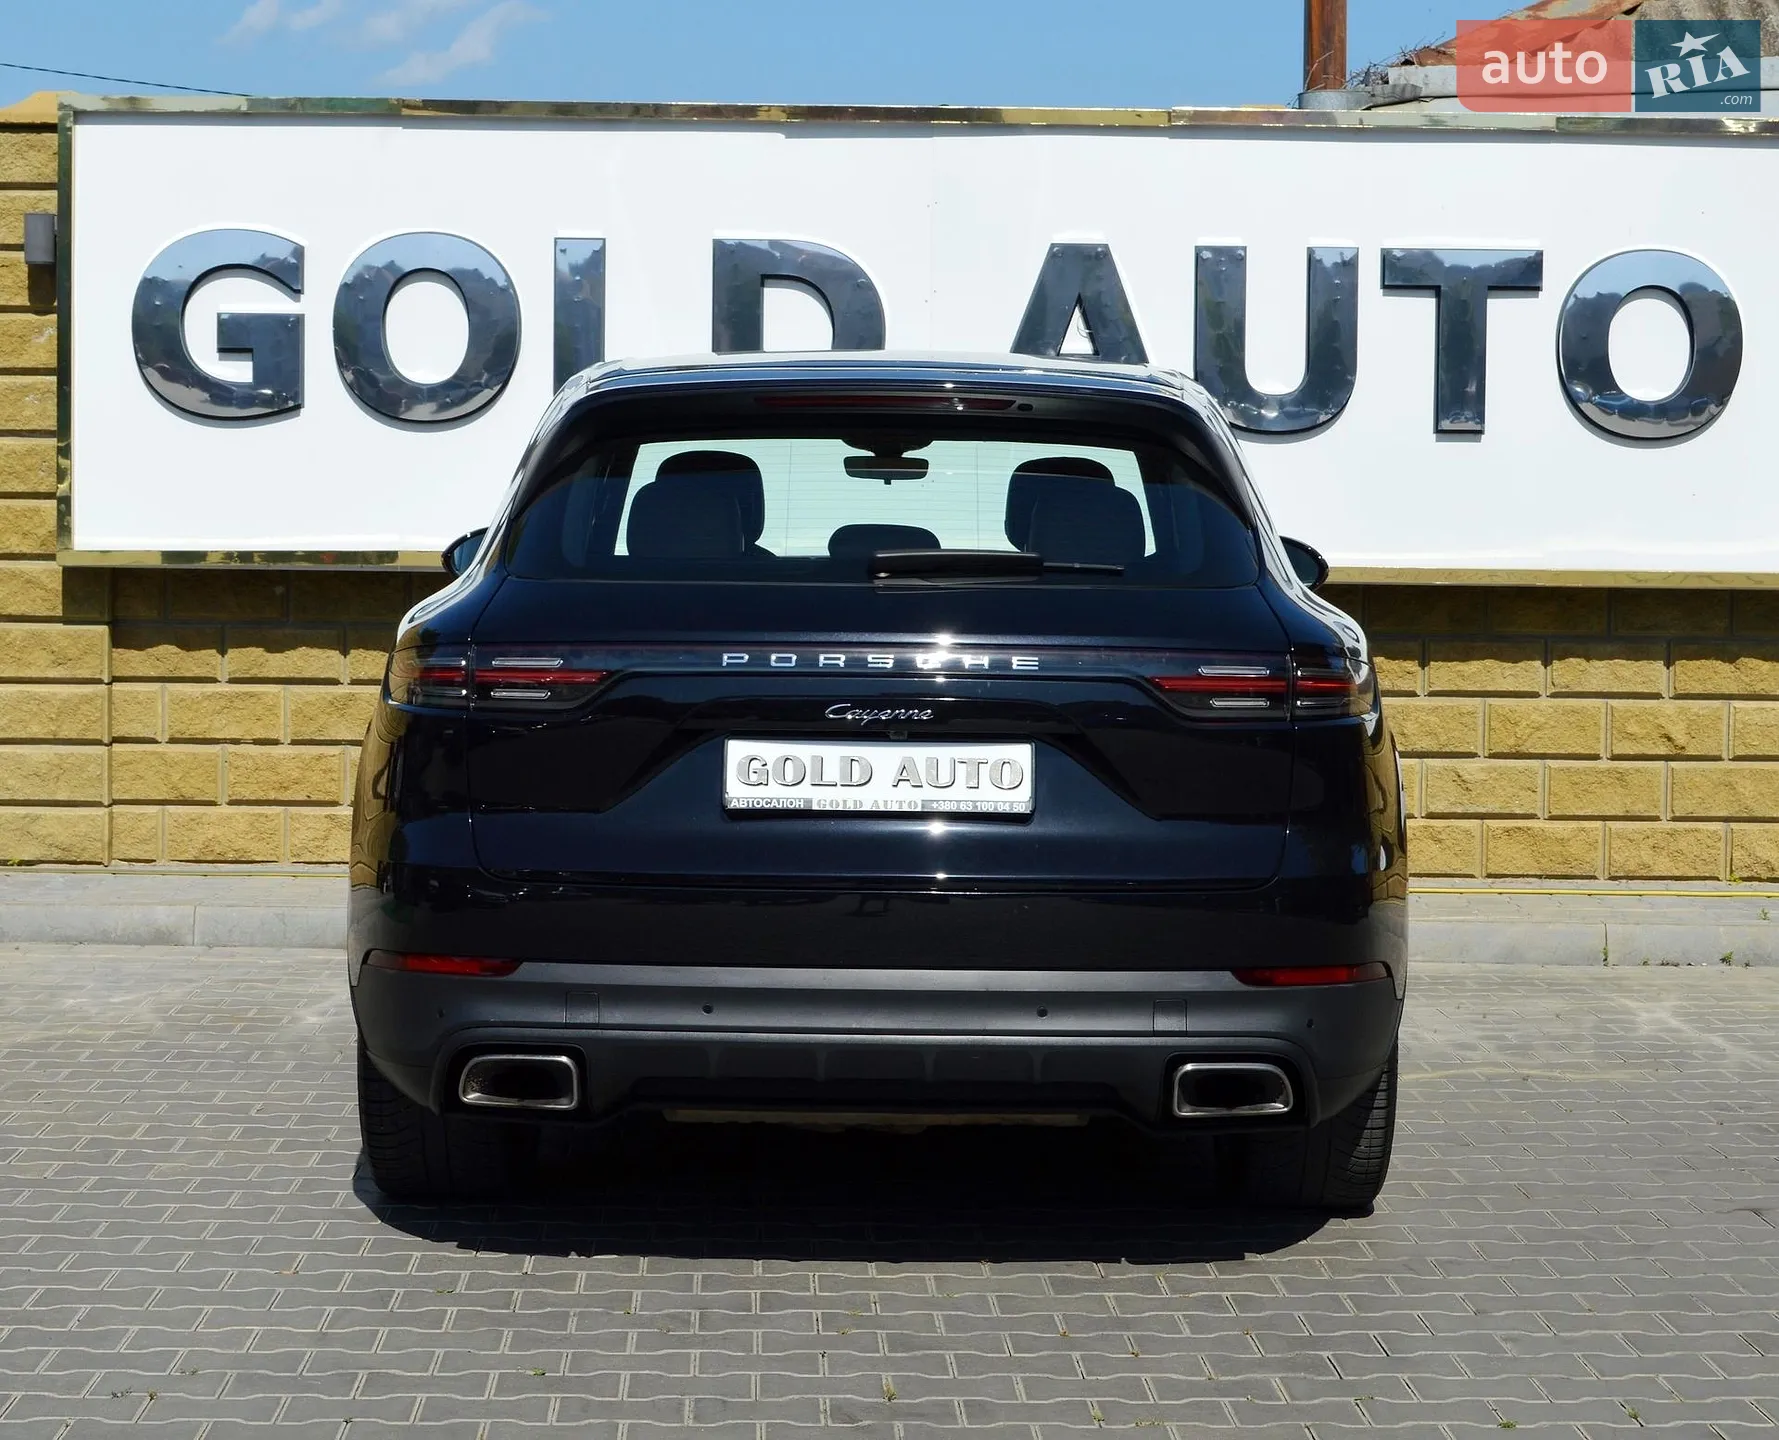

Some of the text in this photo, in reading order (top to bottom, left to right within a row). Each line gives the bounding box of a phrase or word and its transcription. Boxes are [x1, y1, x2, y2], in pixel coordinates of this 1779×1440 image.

[1009, 242, 1744, 441] AUTO
[721, 652, 1040, 670] PORSCHE
[824, 703, 934, 725] Cayenne
[736, 754, 1024, 790] GOLD AUTO
[730, 798, 804, 808] АВТОСАЛОН
[816, 799, 919, 810] GOLD AUTO
[932, 801, 1026, 812] +380 63 100 04 50
